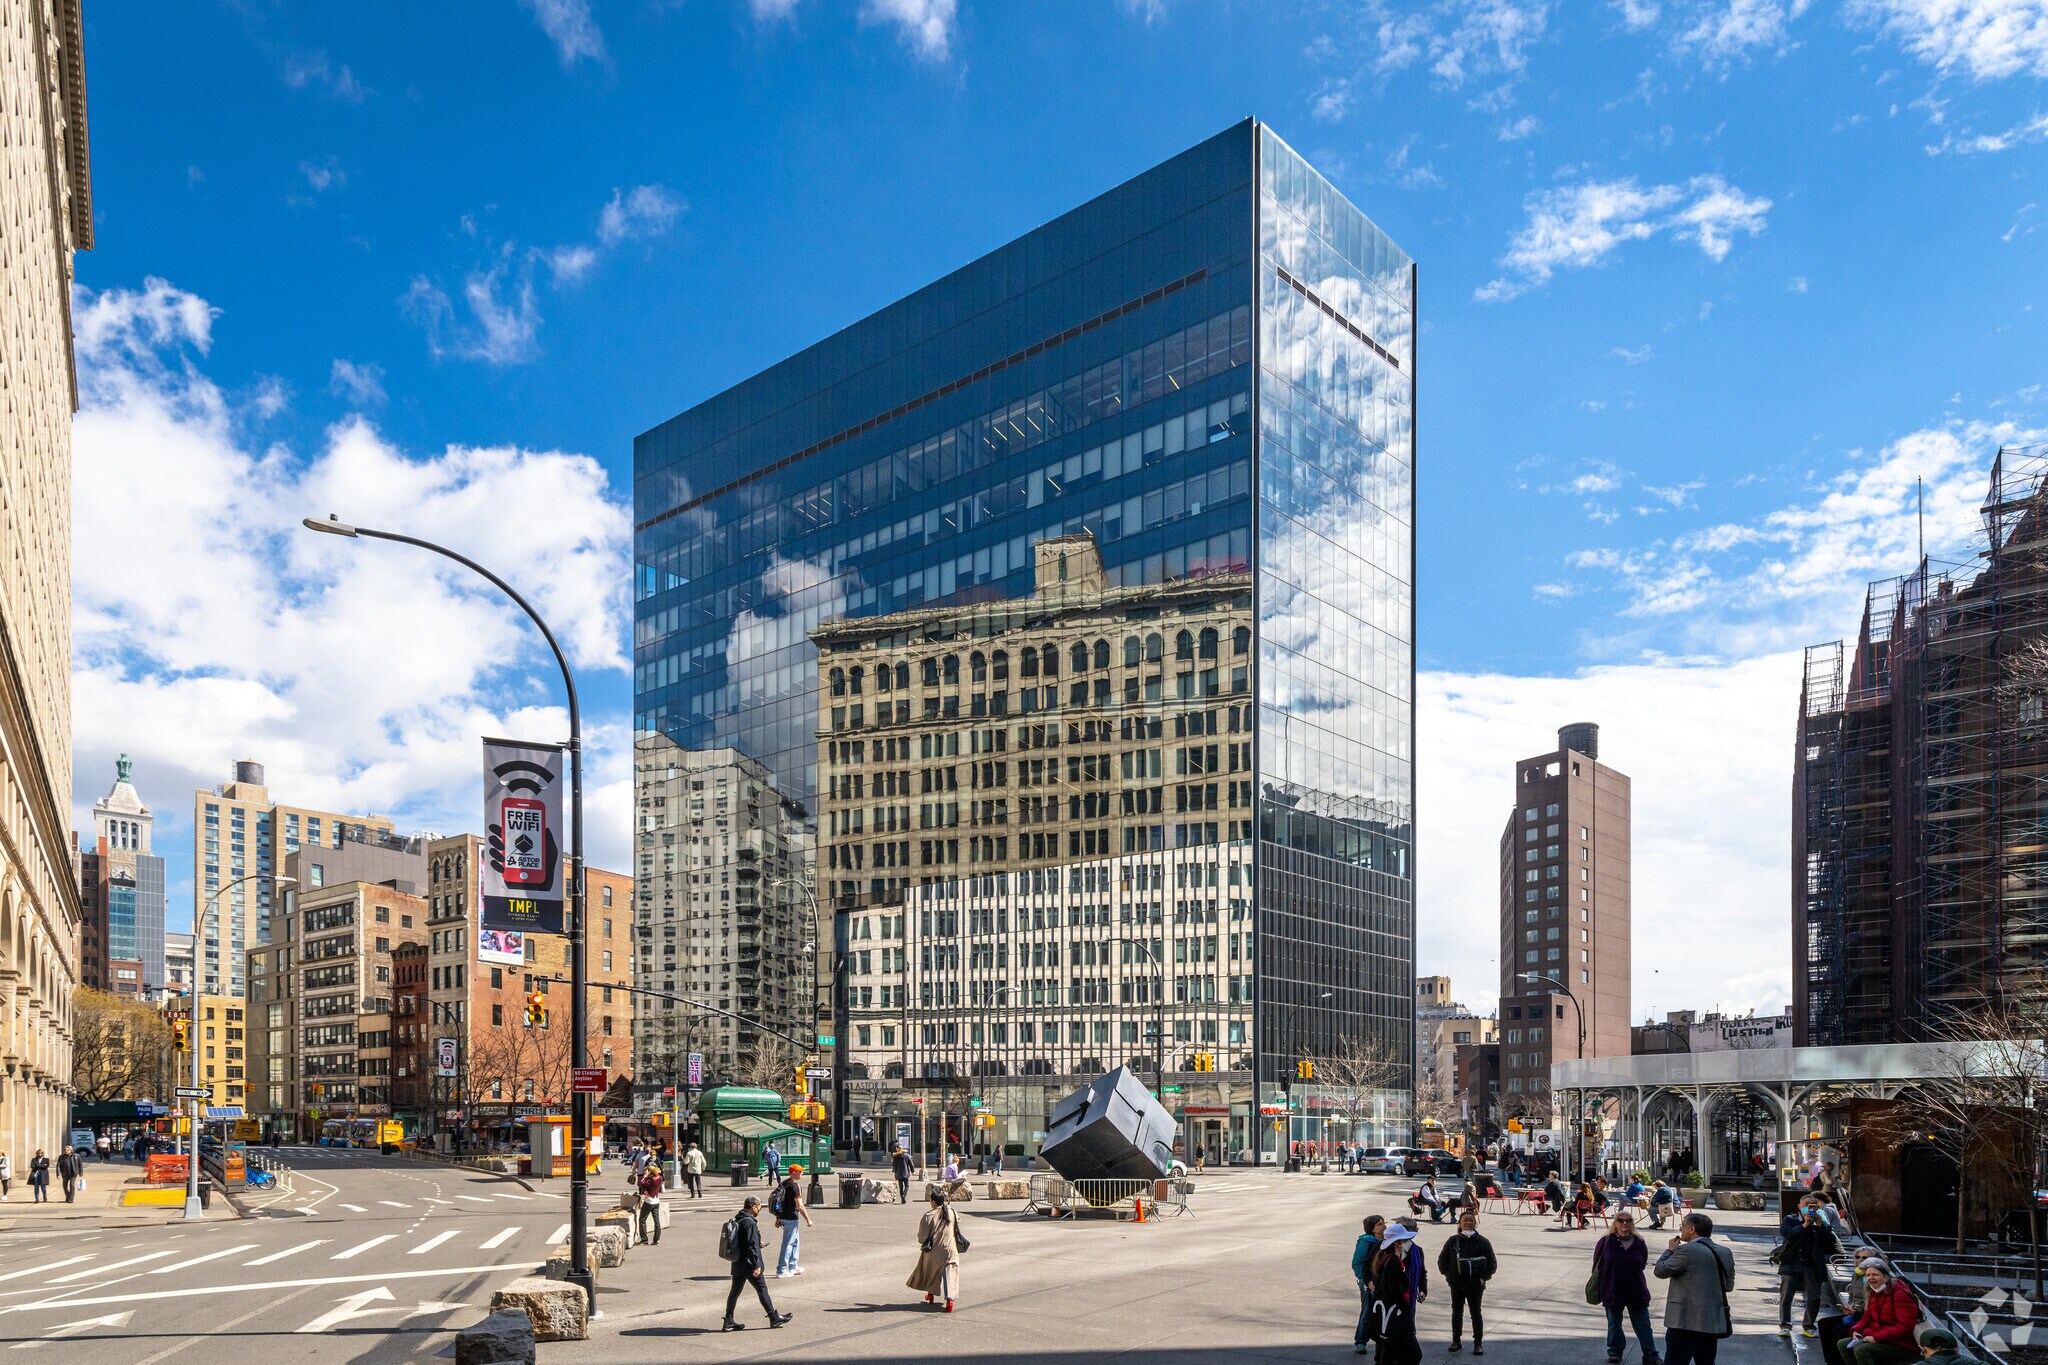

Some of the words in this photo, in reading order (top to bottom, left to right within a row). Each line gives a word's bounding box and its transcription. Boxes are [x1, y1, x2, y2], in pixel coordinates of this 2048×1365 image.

[508, 810, 540, 822] FREE
[508, 820, 540, 832] WIFI
[508, 899, 540, 914] TMPL
[856, 1082, 878, 1090] ASTOR
